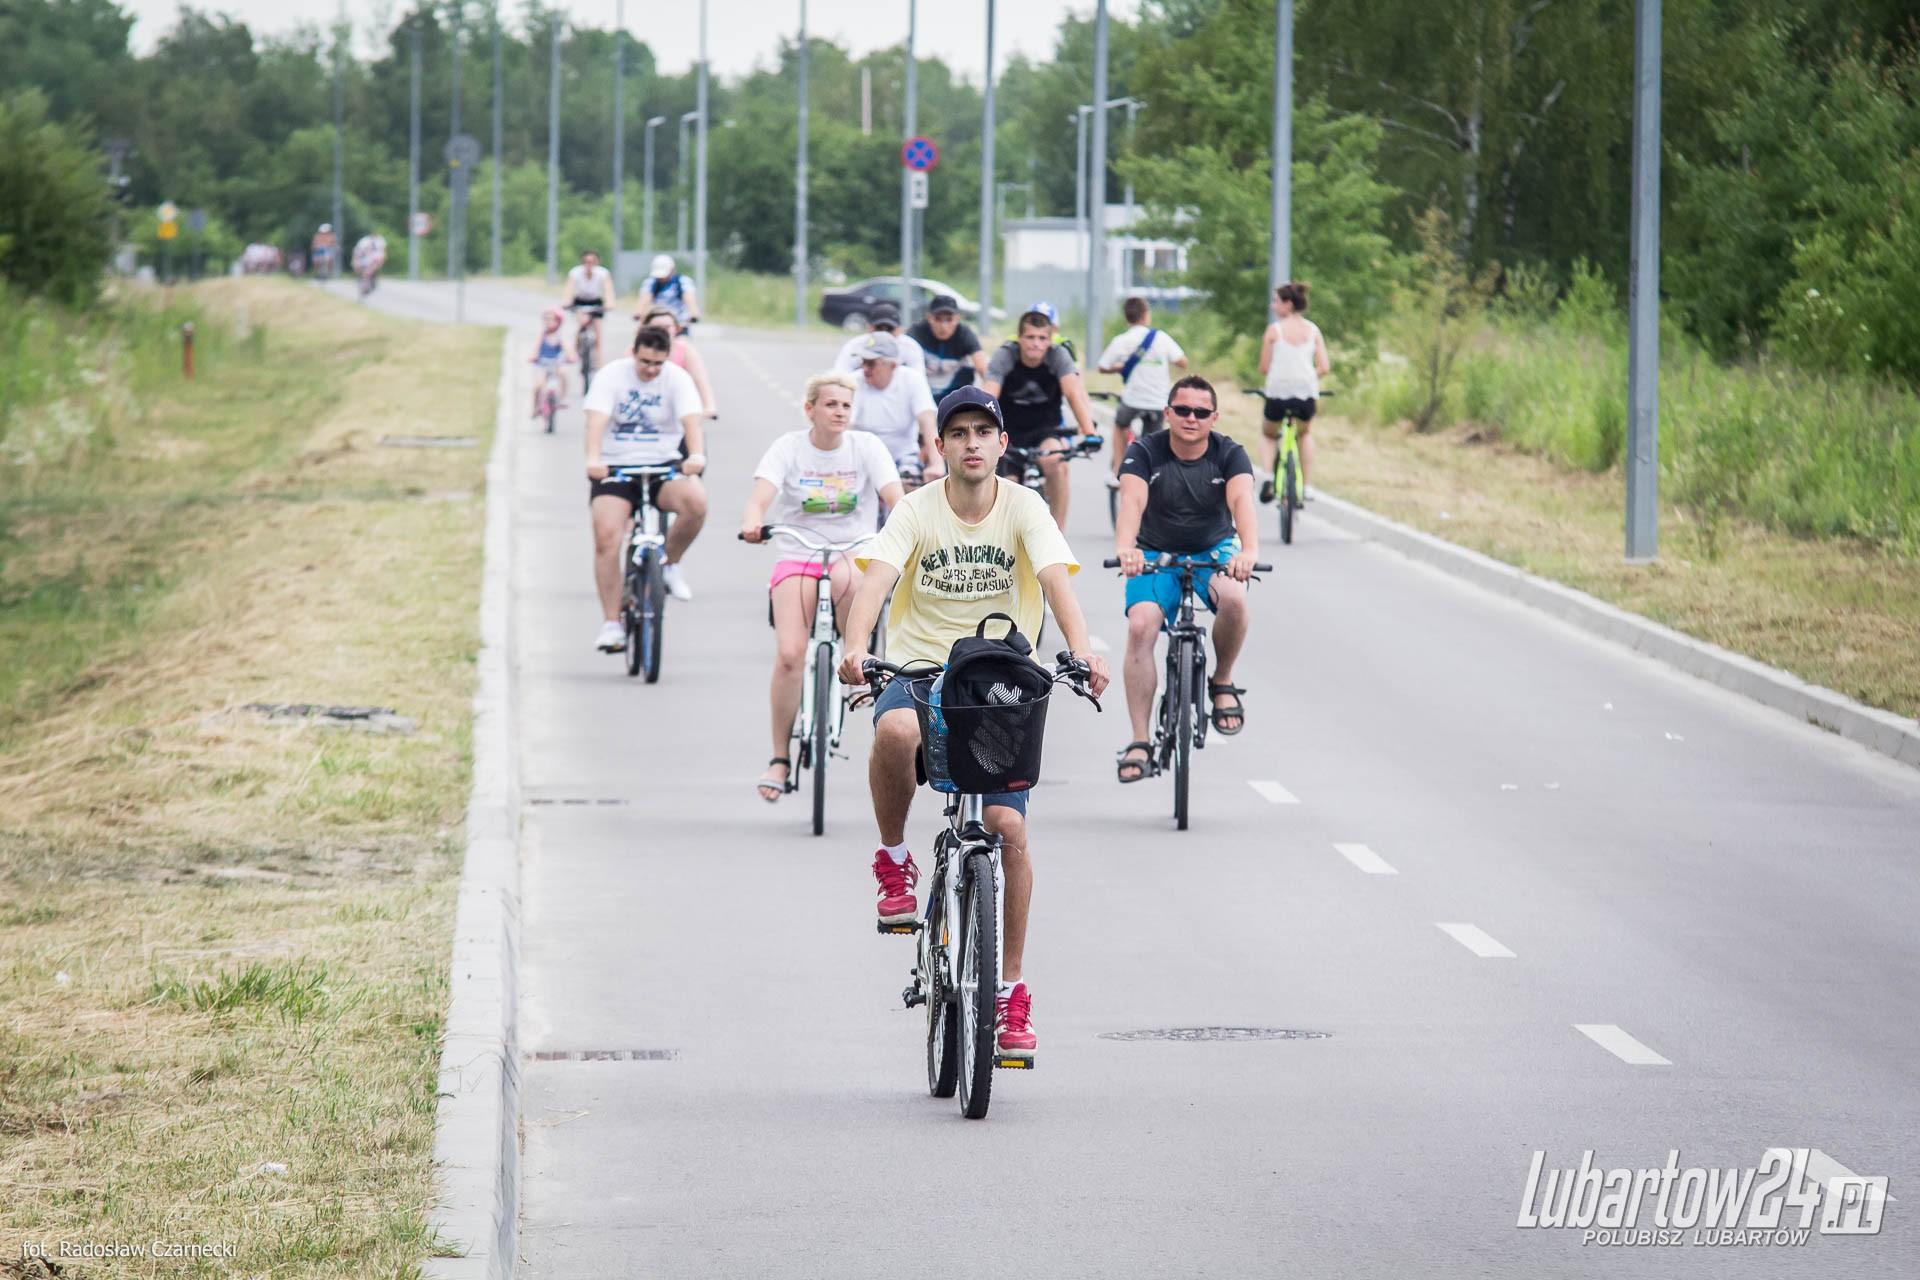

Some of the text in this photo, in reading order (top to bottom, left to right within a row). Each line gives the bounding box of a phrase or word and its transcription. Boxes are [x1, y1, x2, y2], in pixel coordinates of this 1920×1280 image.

[921, 545, 1015, 572] NEW MICHIGAN
[921, 574, 933, 586] C7
[966, 583, 973, 592] &
[976, 575, 1013, 592] CASUALS
[943, 567, 997, 581] CARS JEANS
